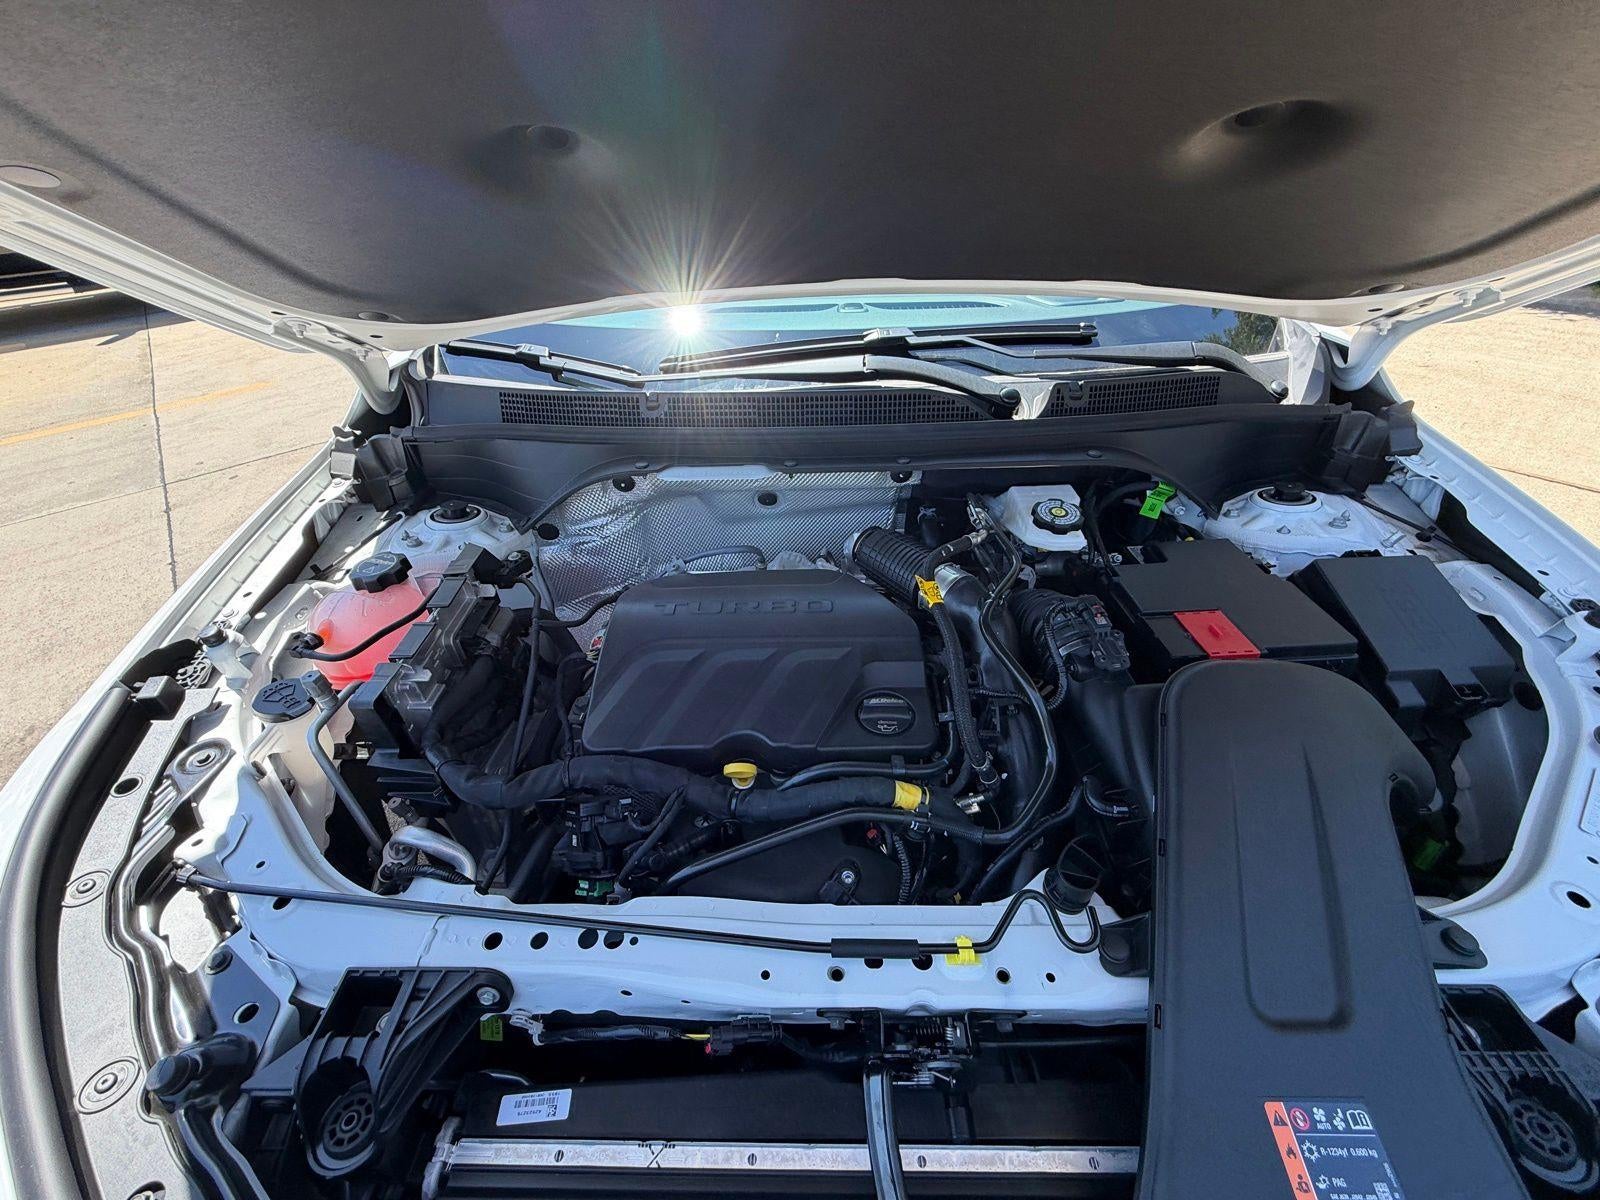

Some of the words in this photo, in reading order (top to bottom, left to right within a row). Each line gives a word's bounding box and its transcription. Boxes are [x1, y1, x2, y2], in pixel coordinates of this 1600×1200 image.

[653, 599, 835, 616] TURBO
[1316, 1122, 1332, 1130] AUTO
[1320, 1146, 1348, 1158] R-1234yf
[1331, 1177, 1347, 1188] PAG
